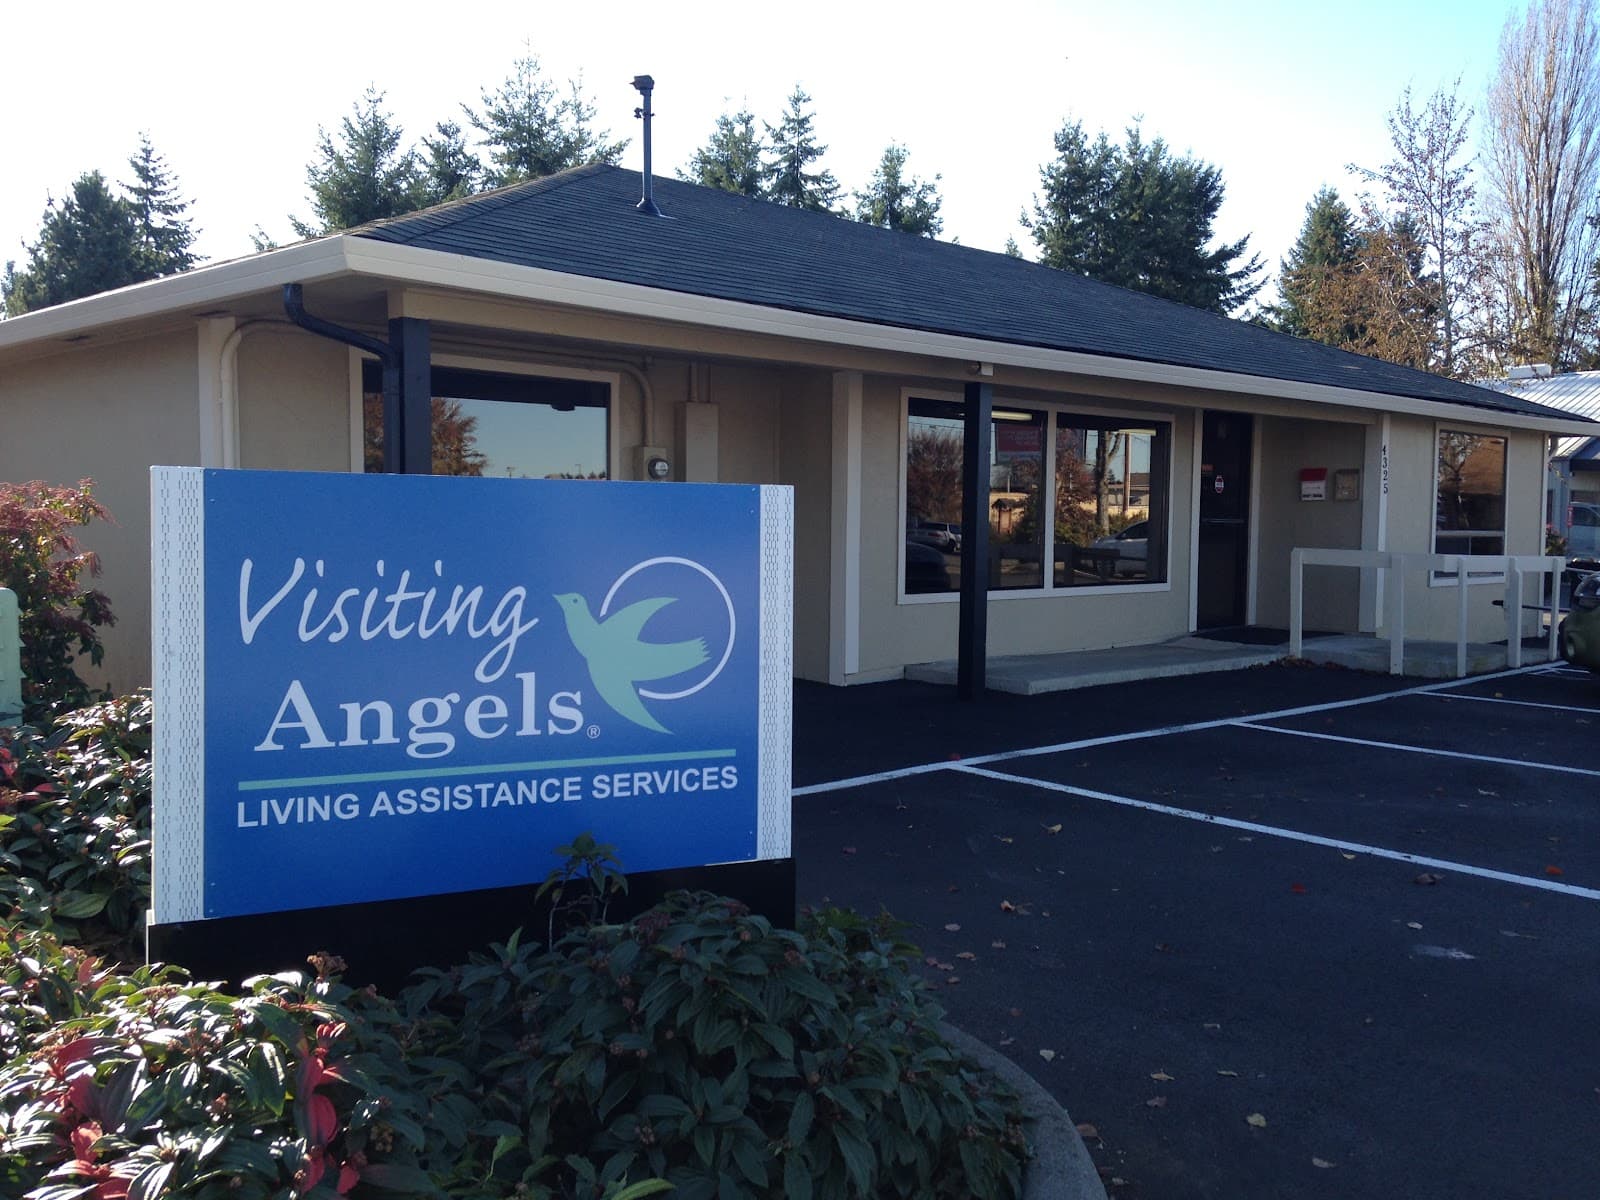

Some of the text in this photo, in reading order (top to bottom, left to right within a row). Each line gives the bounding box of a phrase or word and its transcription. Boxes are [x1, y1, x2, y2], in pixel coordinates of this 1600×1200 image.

[1381, 444, 1390, 494] 4325
[238, 557, 539, 684] Visiting
[237, 765, 739, 828] LIVING ASSISTANCE SERVICES
